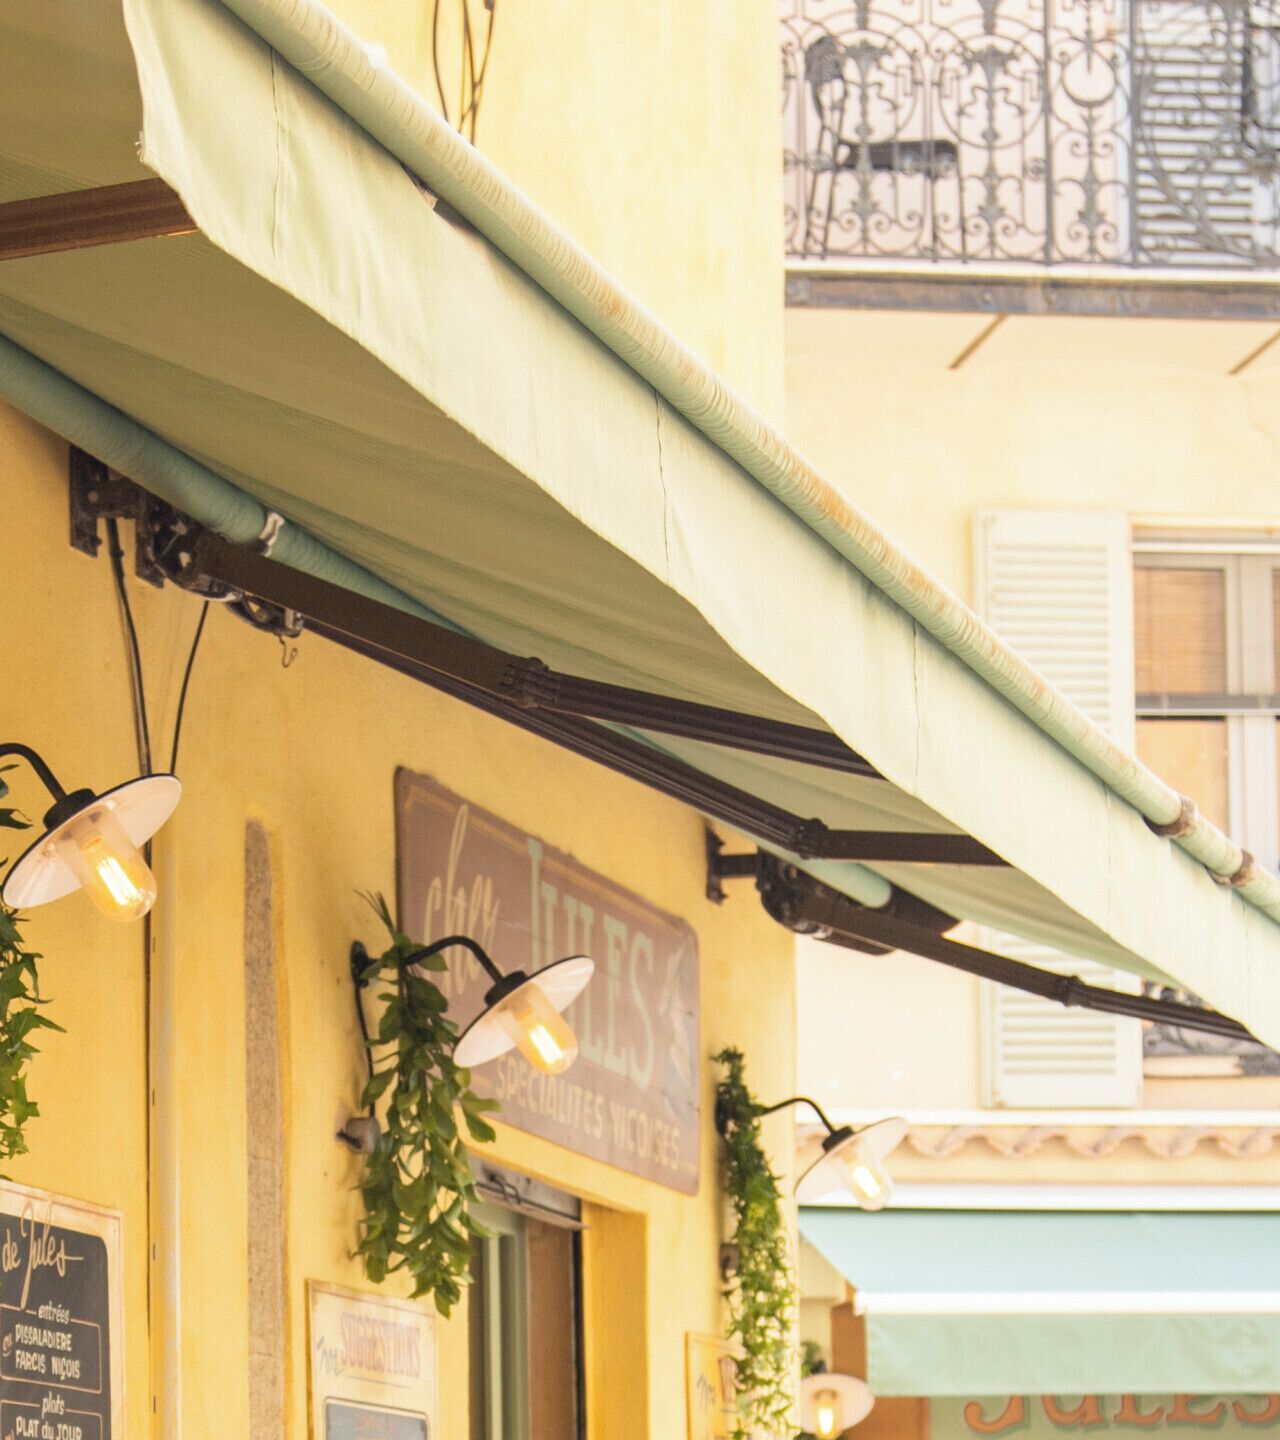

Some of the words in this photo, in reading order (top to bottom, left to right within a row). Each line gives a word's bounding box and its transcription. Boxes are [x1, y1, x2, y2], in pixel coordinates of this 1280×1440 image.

[15, 1350, 46, 1374] FARCIS
[41, 1391, 65, 1419] plats
[15, 1416, 39, 1438] PLAT
[41, 1422, 54, 1440] du
